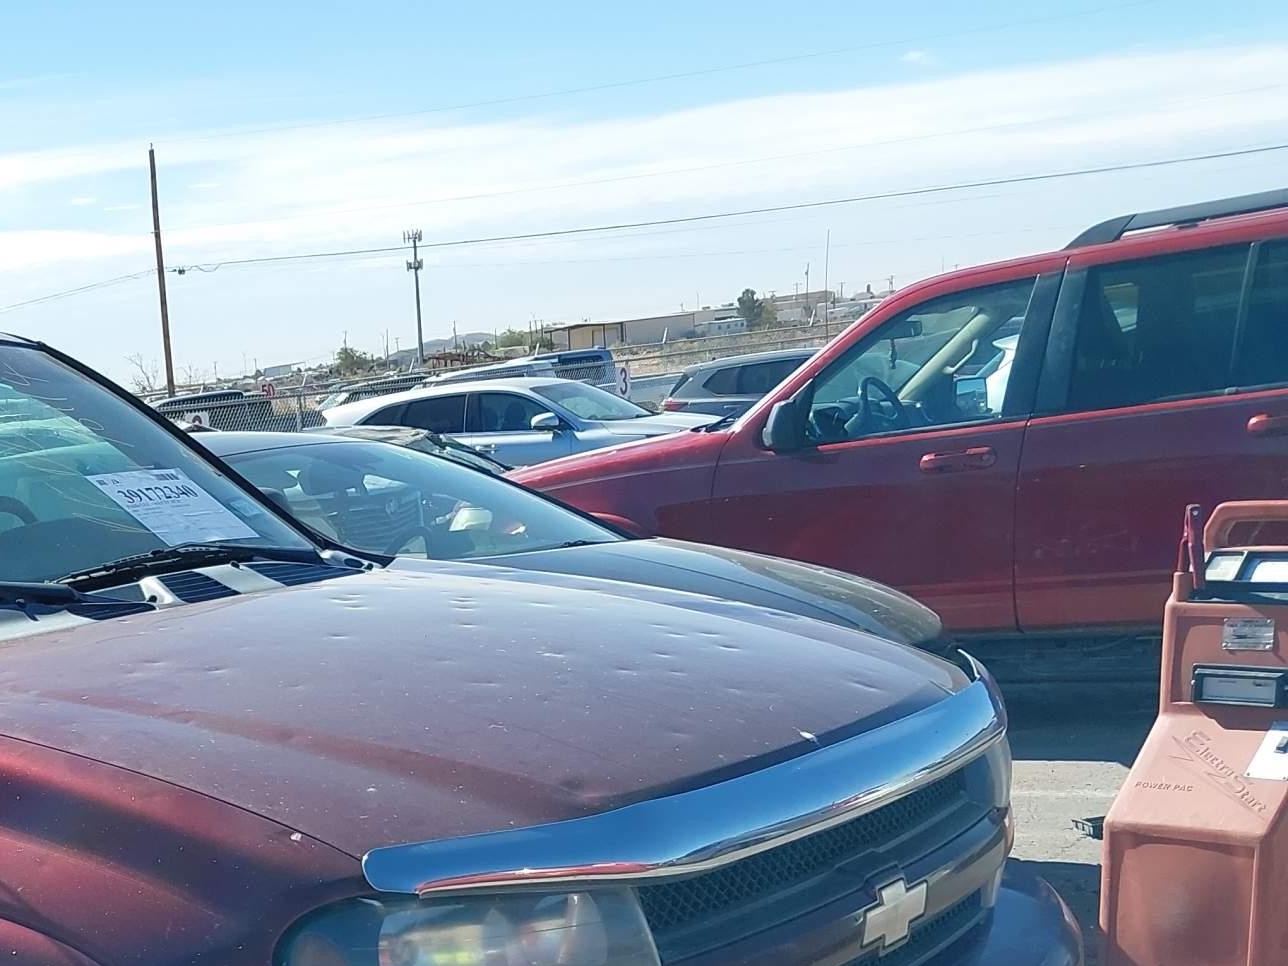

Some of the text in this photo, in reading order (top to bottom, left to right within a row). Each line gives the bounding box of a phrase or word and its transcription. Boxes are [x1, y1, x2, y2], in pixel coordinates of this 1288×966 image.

[619, 367, 628, 396] 3
[117, 484, 199, 504] 39172340
[1134, 780, 1195, 793] POWER PAC
